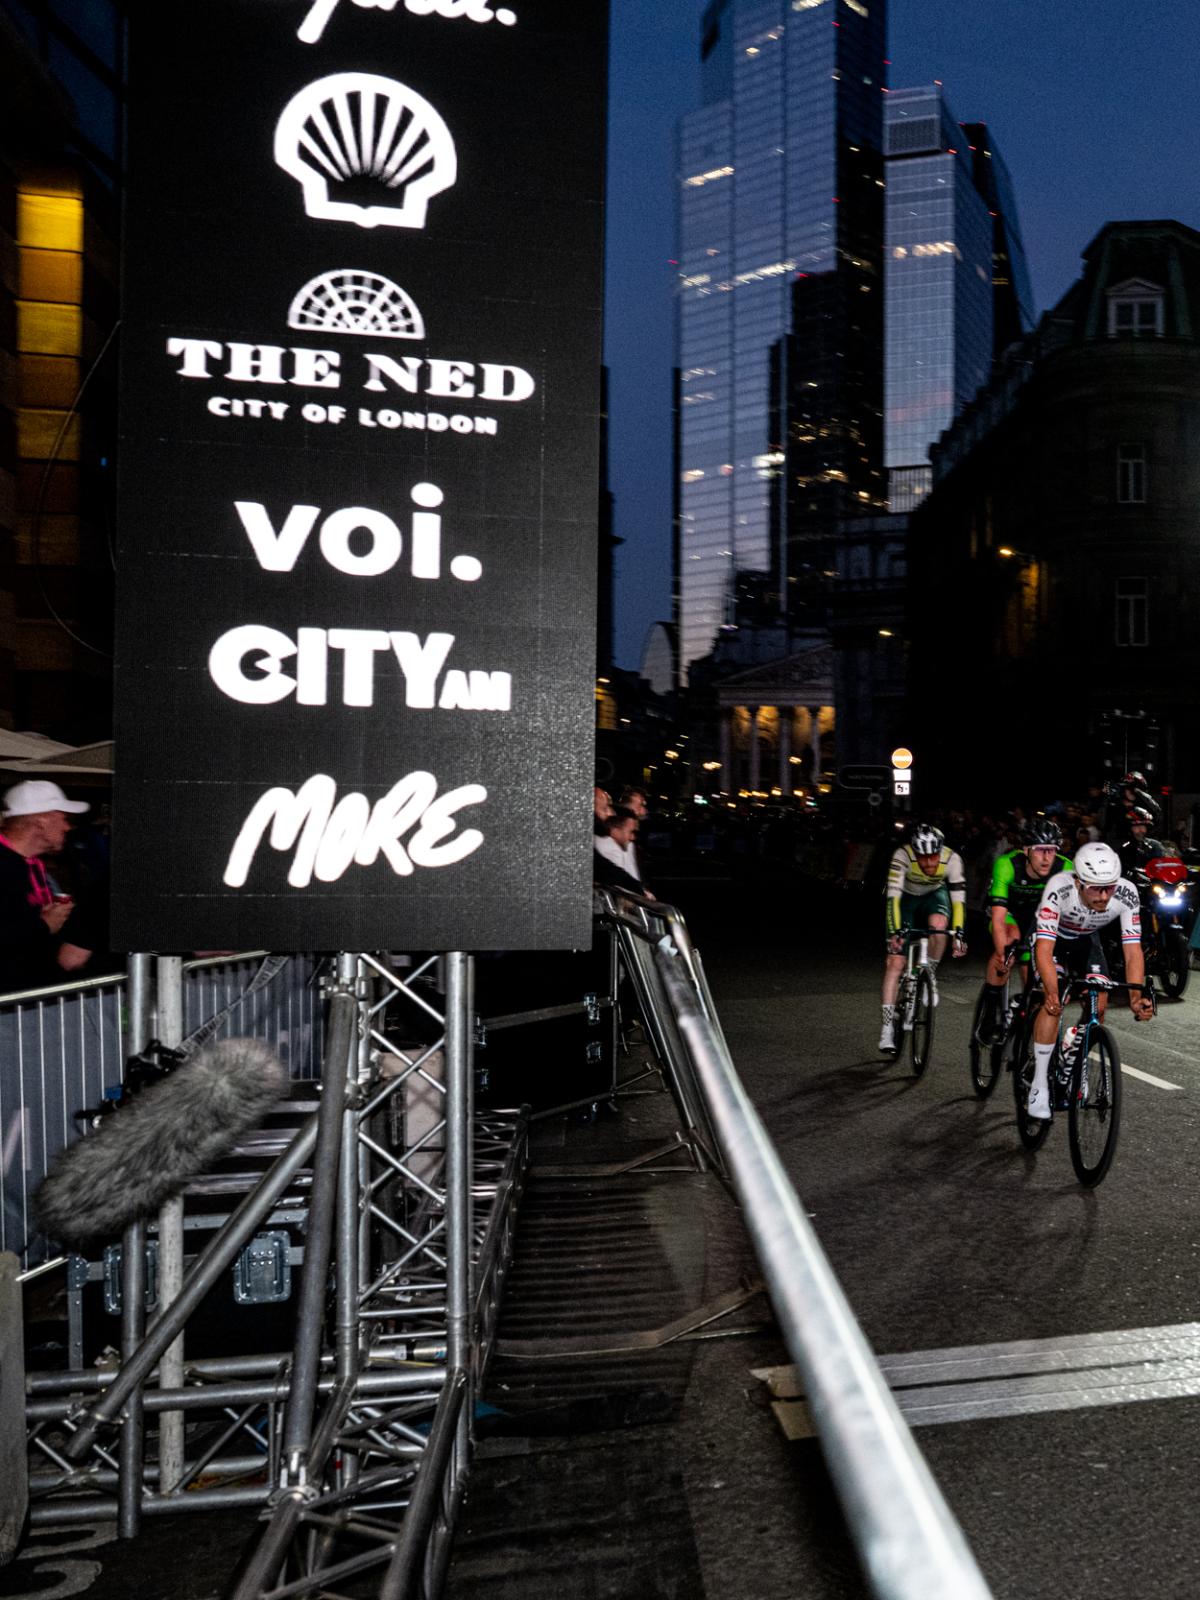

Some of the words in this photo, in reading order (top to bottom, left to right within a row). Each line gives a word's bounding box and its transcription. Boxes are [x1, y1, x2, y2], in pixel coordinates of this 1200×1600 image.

[167, 337, 342, 390] THE
[362, 352, 537, 402] NED
[206, 396, 290, 421] CITY
[301, 402, 347, 425] OF
[357, 407, 499, 437] LONDON
[233, 481, 484, 583] voi.
[223, 770, 488, 888] MORE
